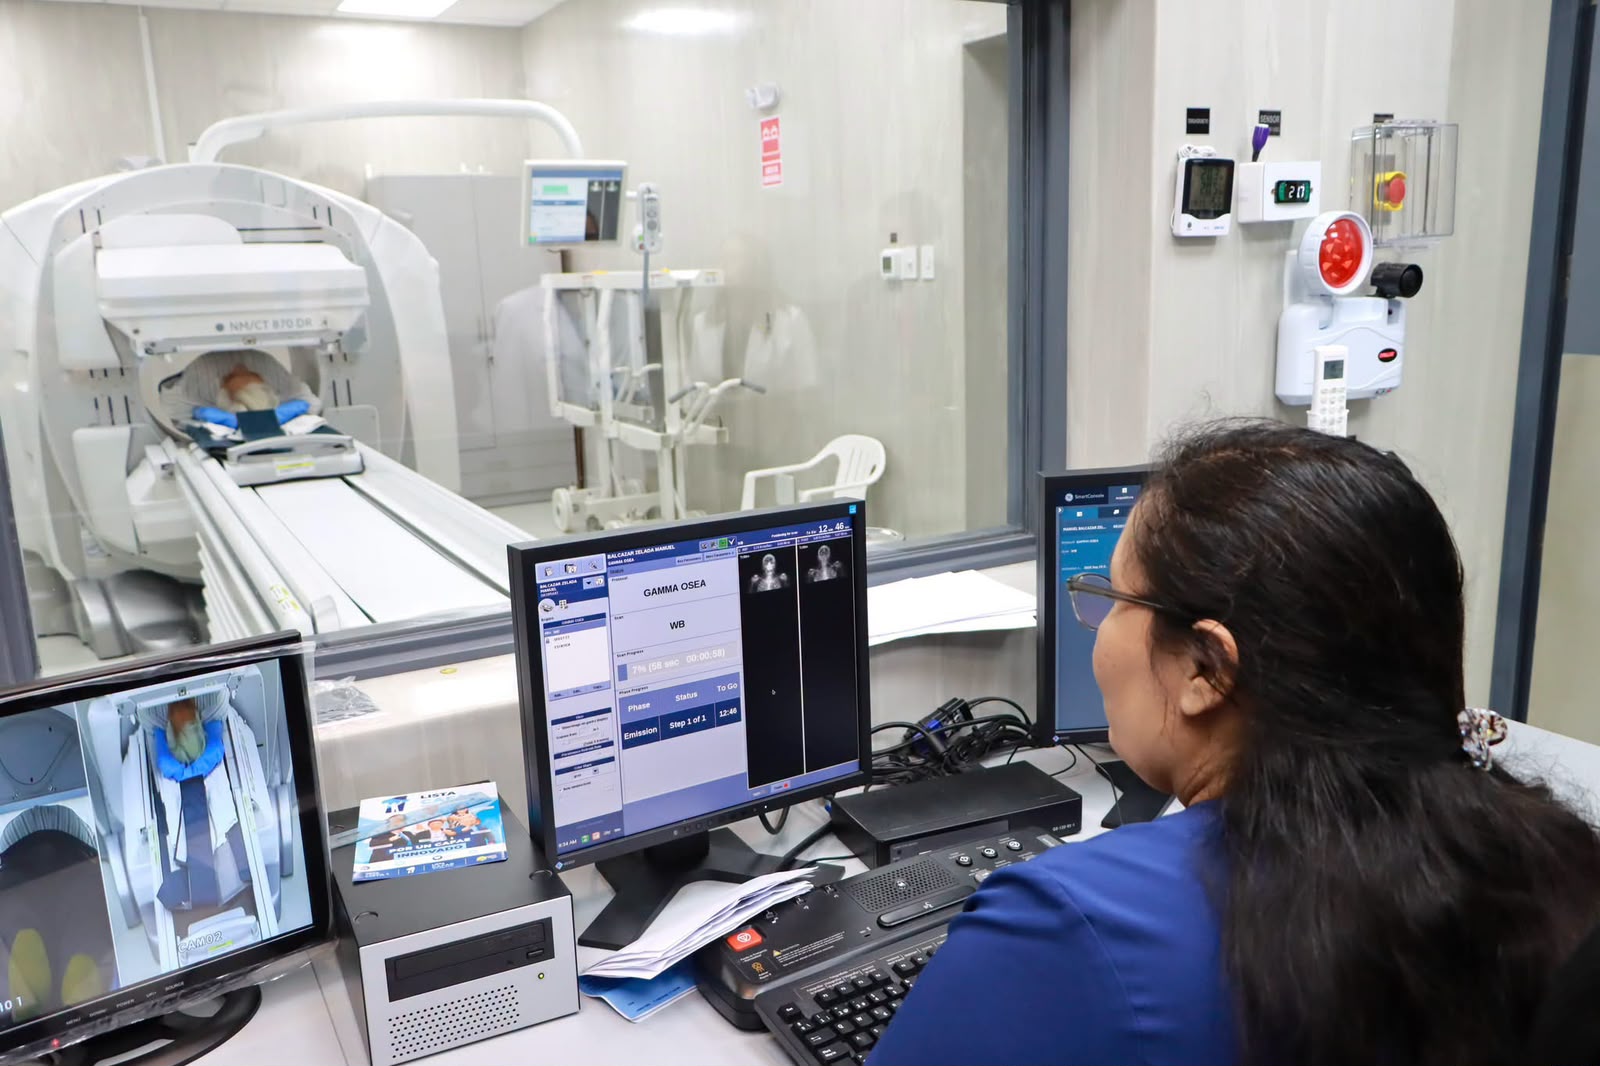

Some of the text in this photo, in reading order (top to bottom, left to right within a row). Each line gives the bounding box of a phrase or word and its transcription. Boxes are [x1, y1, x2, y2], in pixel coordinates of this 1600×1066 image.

[1260, 115, 1280, 124] SENSOR
[229, 319, 269, 331] NM/CT
[295, 317, 313, 328] DR
[819, 524, 828, 533] 12
[834, 522, 844, 530] 46
[607, 551, 635, 560] BALCAZAR
[654, 544, 675, 552] MANUEL
[643, 579, 707, 597] GAMMA OSEA
[669, 619, 686, 631] WB
[632, 665, 647, 675] 7%
[648, 661, 662, 673] (58
[664, 659, 680, 668] sec
[628, 702, 651, 712] Phase
[675, 691, 698, 702] Status
[727, 682, 738, 690] Go
[624, 726, 658, 740] Emission
[669, 719, 686, 730] Step
[692, 716, 701, 724] of
[719, 707, 738, 718] 12:46
[420, 791, 456, 800] LISTA
[388, 846, 413, 854] POR
[178, 930, 223, 953] CAM02
[116, 998, 135, 1008] POWER
